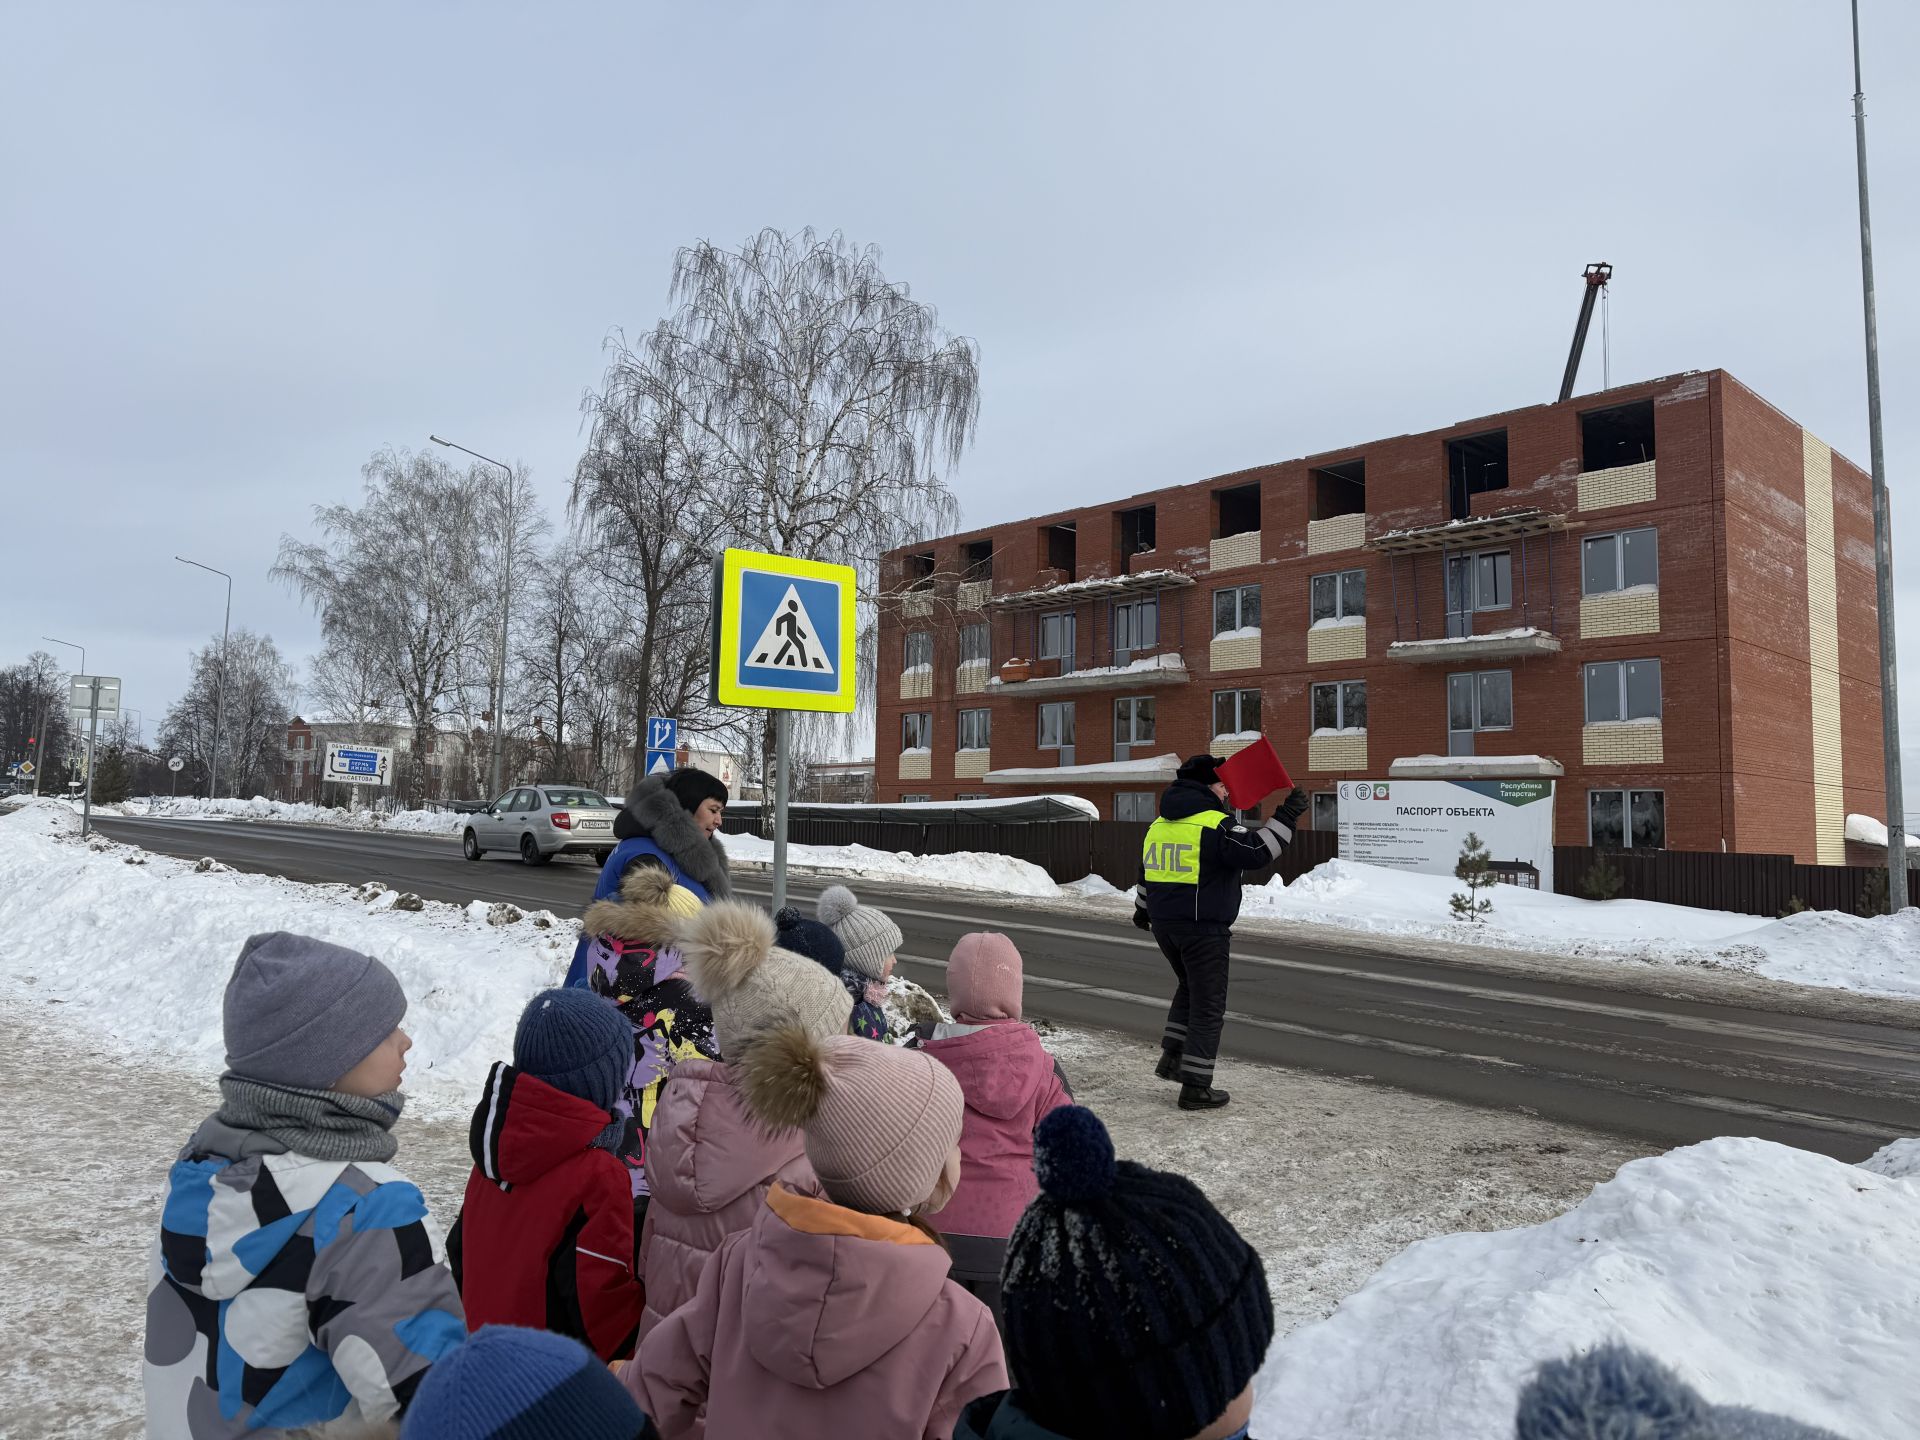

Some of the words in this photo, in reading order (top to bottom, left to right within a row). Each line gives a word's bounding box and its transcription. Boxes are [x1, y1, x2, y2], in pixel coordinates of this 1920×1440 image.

[1500, 782, 1543, 790] Республика
[1500, 790, 1537, 798] Татарстан
[1396, 806, 1443, 816] ПАСПОРТ
[1445, 807, 1495, 817] ОБЪЕКТА
[1143, 842, 1193, 873] ДПС
